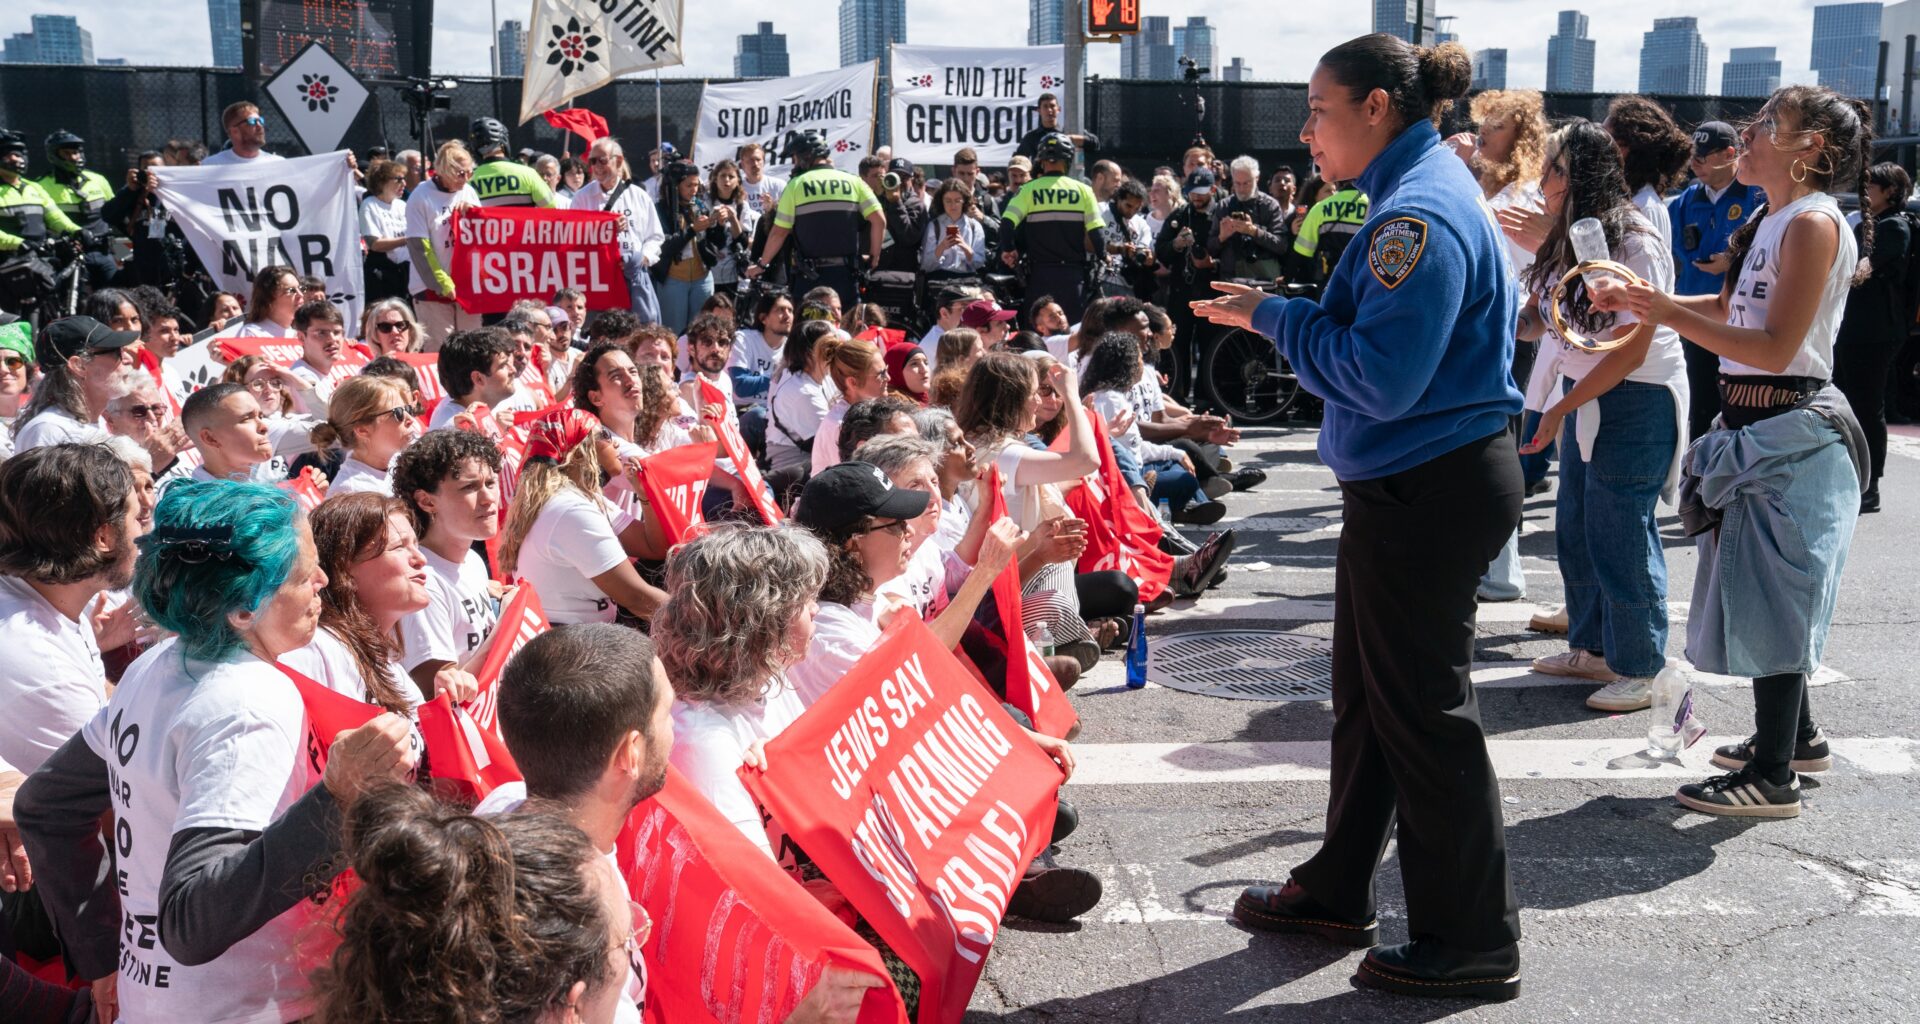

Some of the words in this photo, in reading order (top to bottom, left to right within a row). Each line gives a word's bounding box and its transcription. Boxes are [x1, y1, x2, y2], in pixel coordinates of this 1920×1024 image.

[303, 0, 368, 31] MUST
[1120, 0, 1137, 23] 18
[591, 0, 675, 61] STINE
[276, 31, 395, 70] UTIZE
[945, 67, 984, 97] END
[992, 67, 1026, 97] THE
[717, 106, 768, 138] STOP
[906, 104, 1040, 144] GENOCI
[1692, 131, 1709, 143] PD
[471, 175, 520, 195] NYPD
[803, 180, 852, 197] NYPD
[1032, 189, 1080, 205] NYPD
[217, 184, 300, 233] NO
[1323, 201, 1366, 219] NYPD
[459, 218, 515, 245] STOP
[521, 220, 614, 245] ARMING
[1374, 228, 1420, 245] DEPARTMENT
[1384, 222, 1410, 233] POLICE
[471, 251, 609, 294] ISRAEL
[1395, 263, 1409, 279] NEW
[1406, 243, 1421, 263] YORK
[461, 591, 493, 624] FUN
[110, 707, 140, 767] NO
[823, 695, 890, 801] JEWS
[880, 652, 935, 730] SAY
[886, 693, 1014, 850] ARMING
[119, 941, 172, 988] ESTINE
